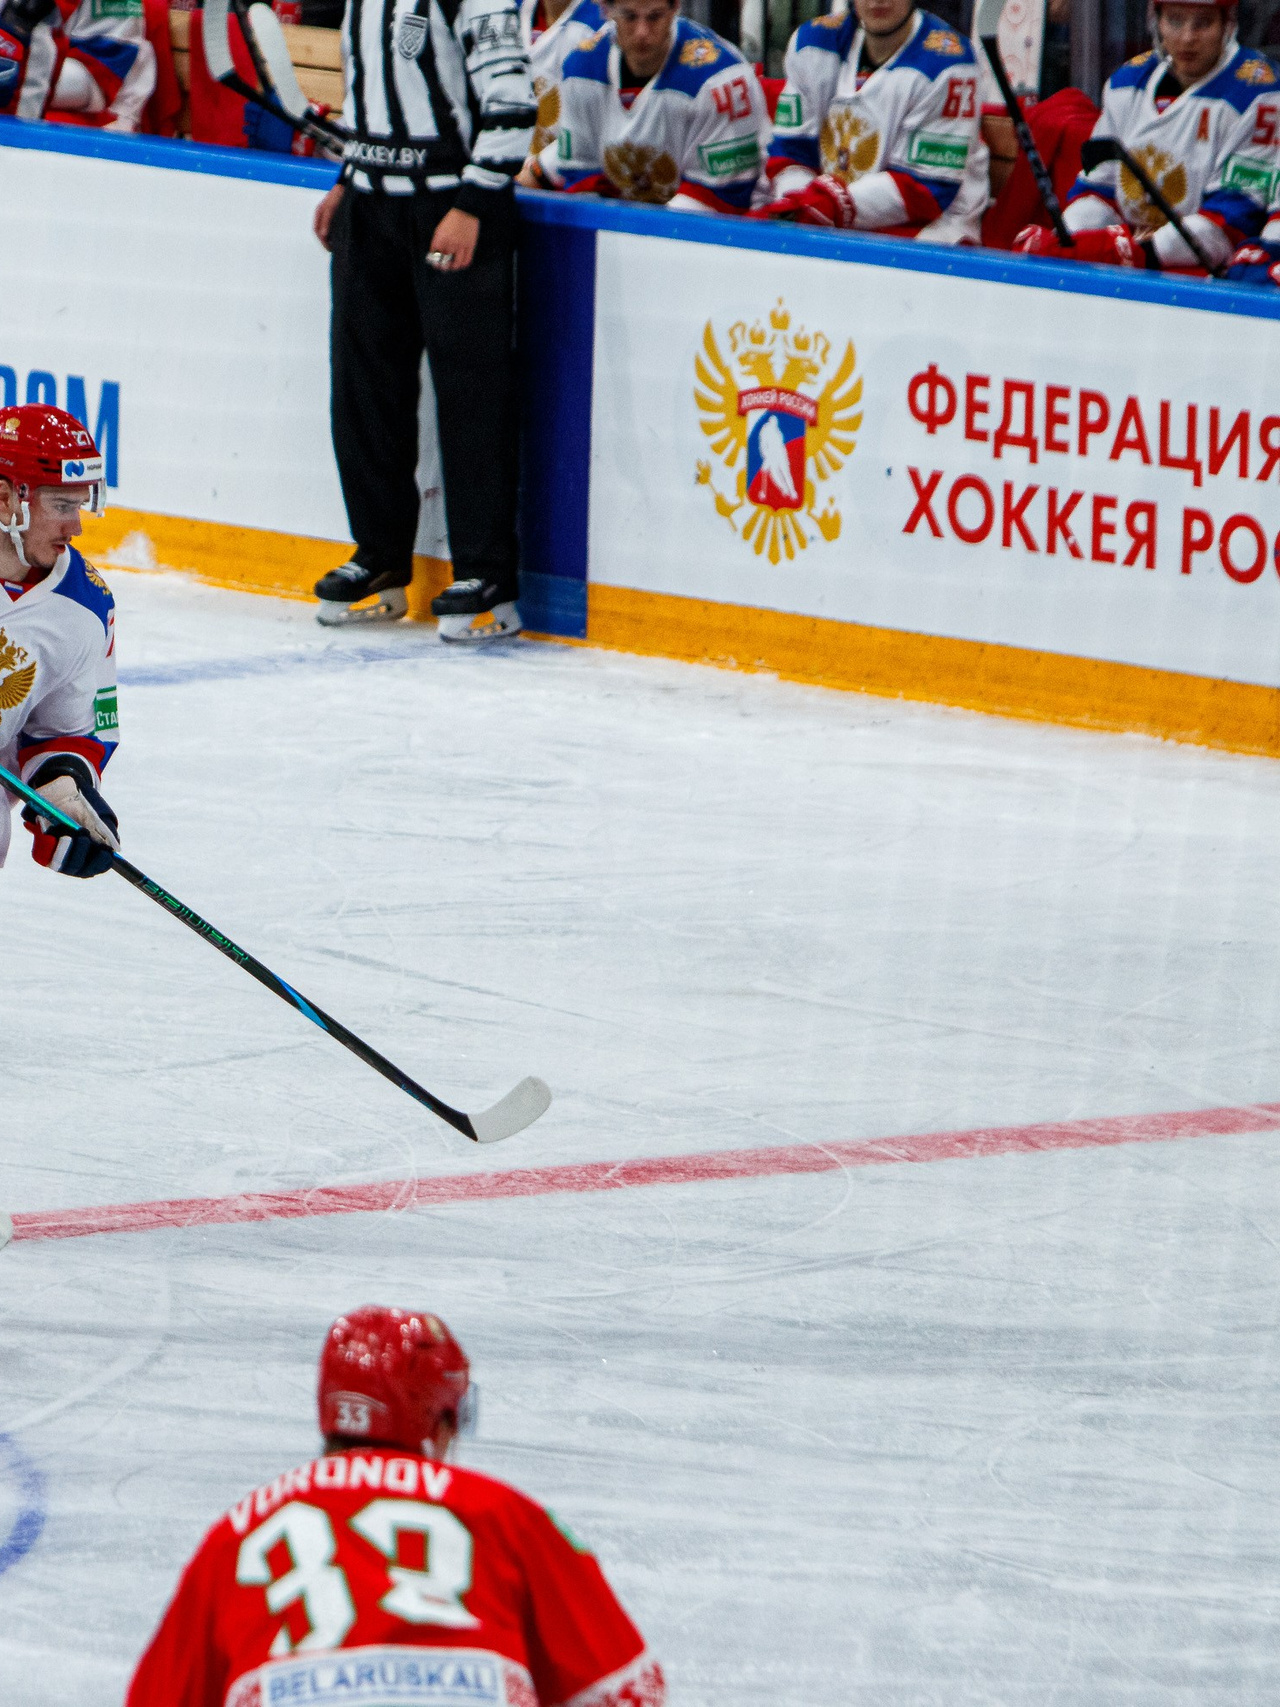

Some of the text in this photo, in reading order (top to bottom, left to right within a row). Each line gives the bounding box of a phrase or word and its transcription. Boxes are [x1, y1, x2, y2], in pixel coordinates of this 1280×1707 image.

[710, 76, 753, 122] 43
[941, 77, 976, 119] 63
[71, 431, 92, 446] 27
[907, 362, 1280, 488] ФЕДЕРАЦИЯ
[902, 465, 1280, 585] ХОККЕЯ РО
[336, 1401, 369, 1430] 33
[228, 1455, 453, 1534] VORONOV
